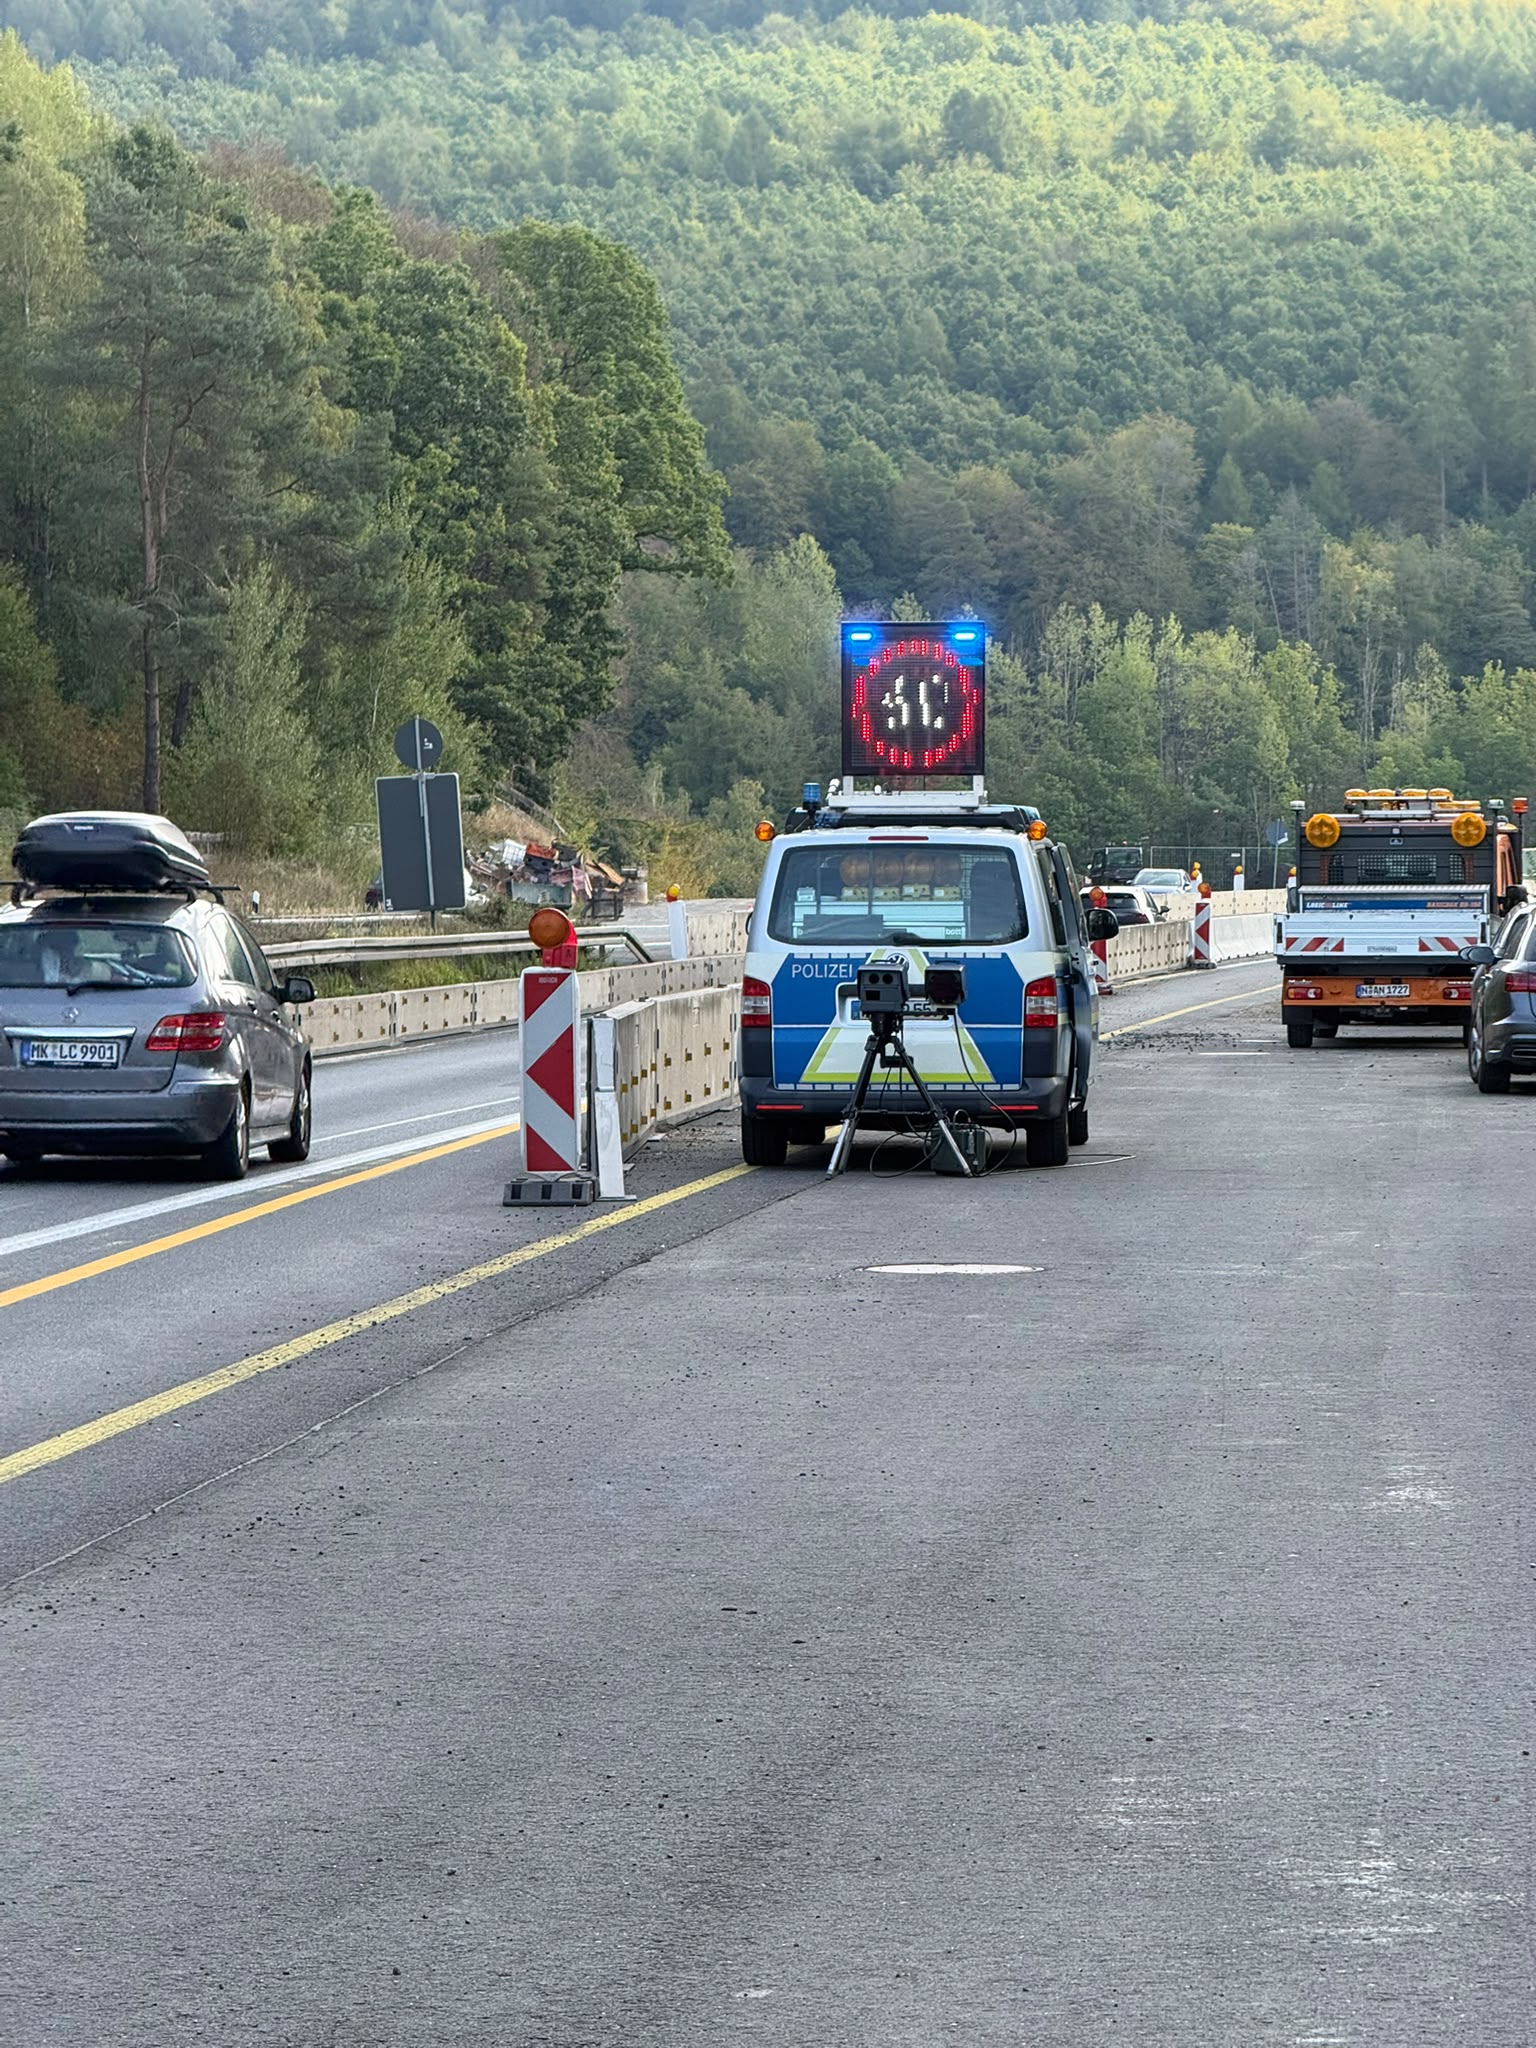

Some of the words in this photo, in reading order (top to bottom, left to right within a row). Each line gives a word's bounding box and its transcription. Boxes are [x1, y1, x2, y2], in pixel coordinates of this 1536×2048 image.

[792, 964, 853, 978] POLIZEI
[1361, 986, 1368, 995] N
[1386, 985, 1409, 995] 1727
[31, 1044, 48, 1058] MK
[59, 1044, 77, 1059] LC
[81, 1045, 114, 1060] 9901
